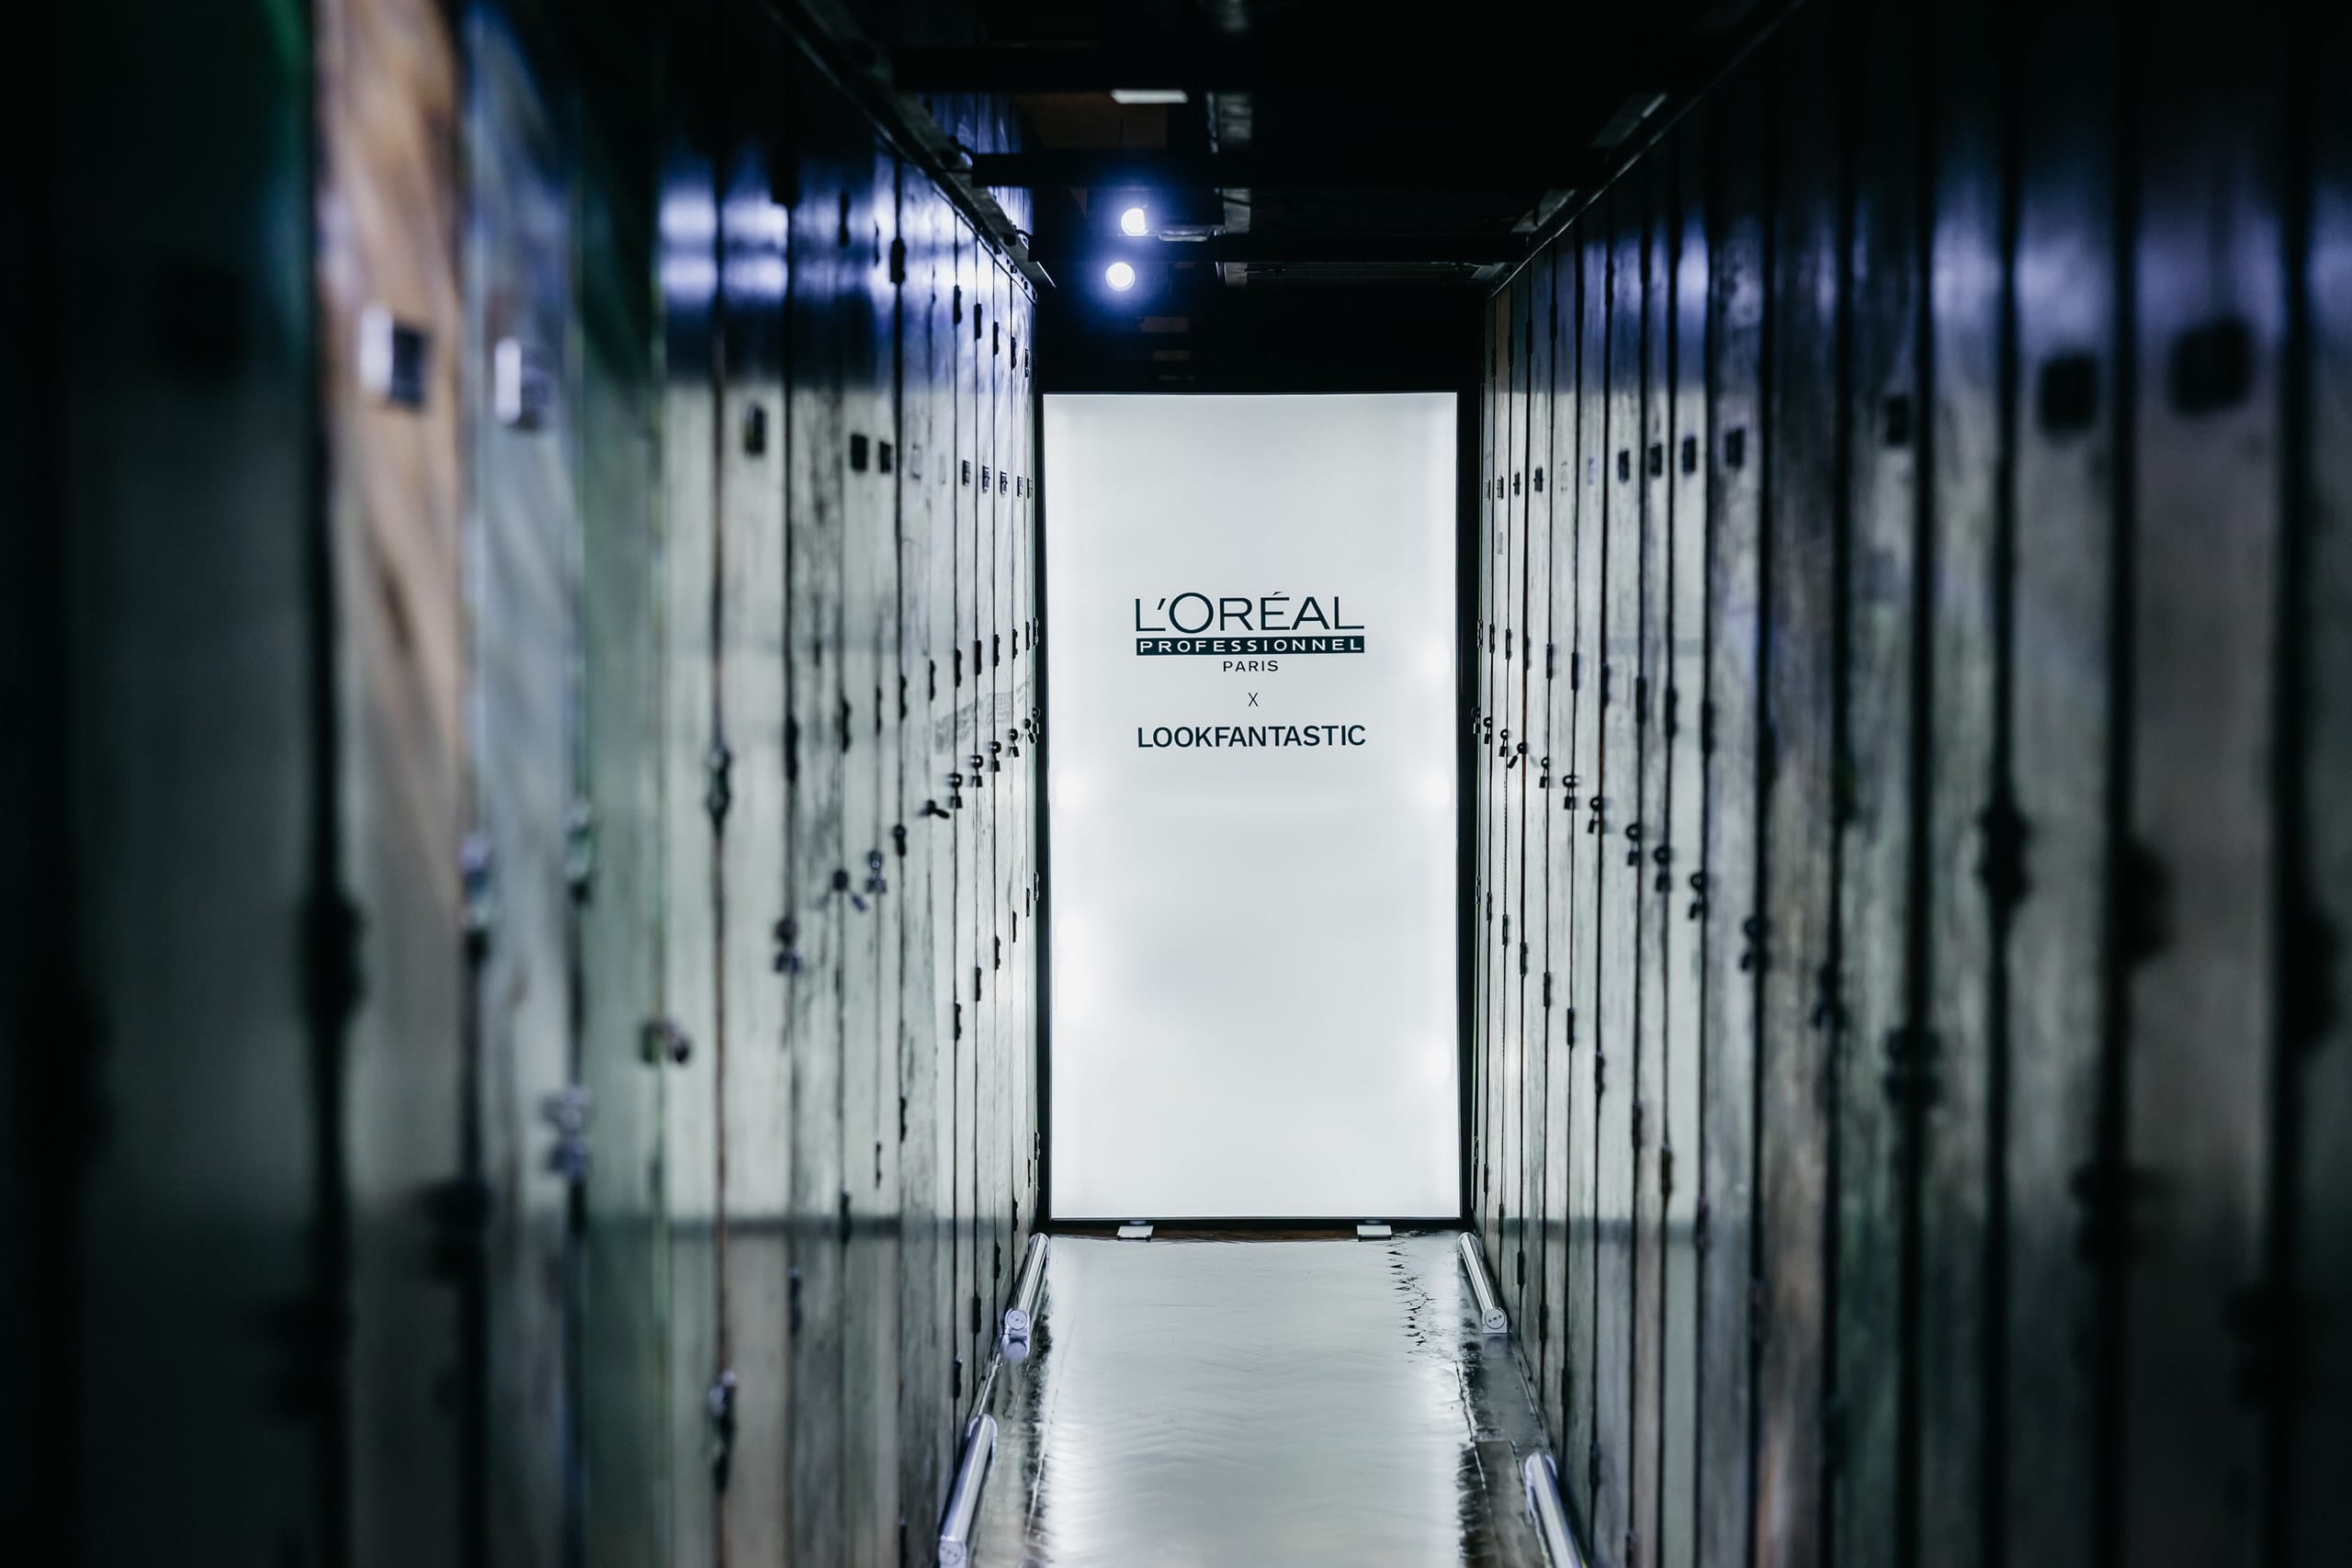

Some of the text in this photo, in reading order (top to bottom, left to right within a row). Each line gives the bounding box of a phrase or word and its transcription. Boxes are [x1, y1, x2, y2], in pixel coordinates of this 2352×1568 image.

[1140, 638, 1362, 653] PROFESSIONNEL
[1223, 660, 1279, 672] PARIS
[1137, 725, 1366, 748] LOOKFANTASTIC
